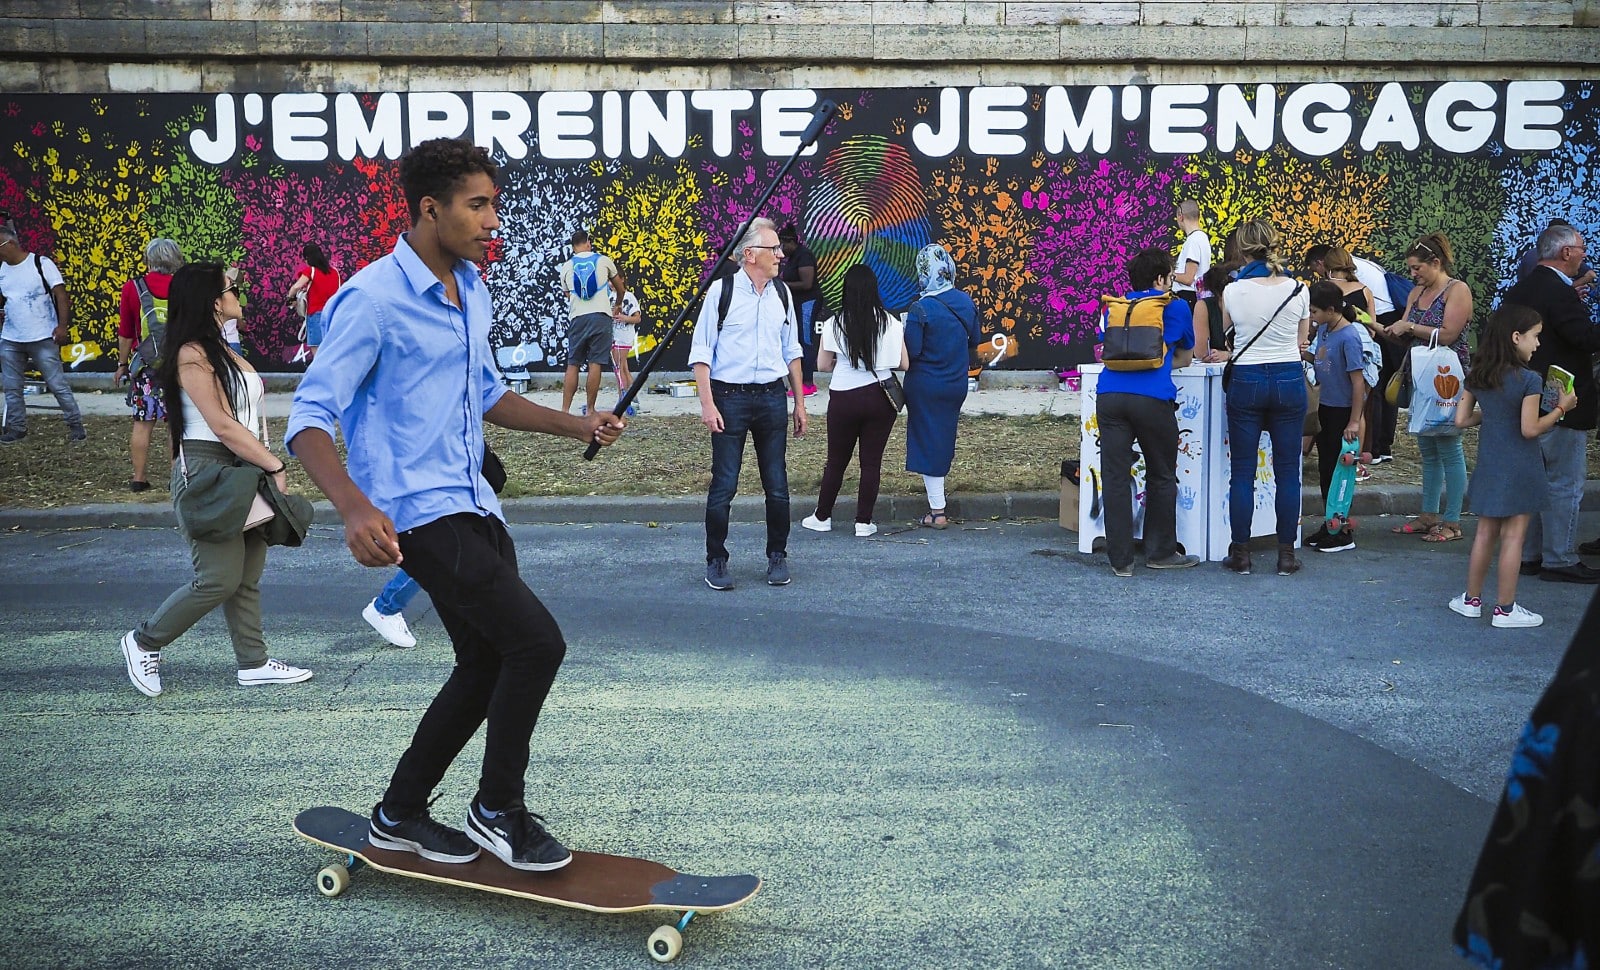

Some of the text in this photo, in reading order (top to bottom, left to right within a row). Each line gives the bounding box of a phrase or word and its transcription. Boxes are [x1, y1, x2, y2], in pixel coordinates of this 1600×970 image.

[189, 89, 819, 165] J'EMPREINTE
[512, 342, 527, 365] 6
[988, 332, 1008, 366] 9
